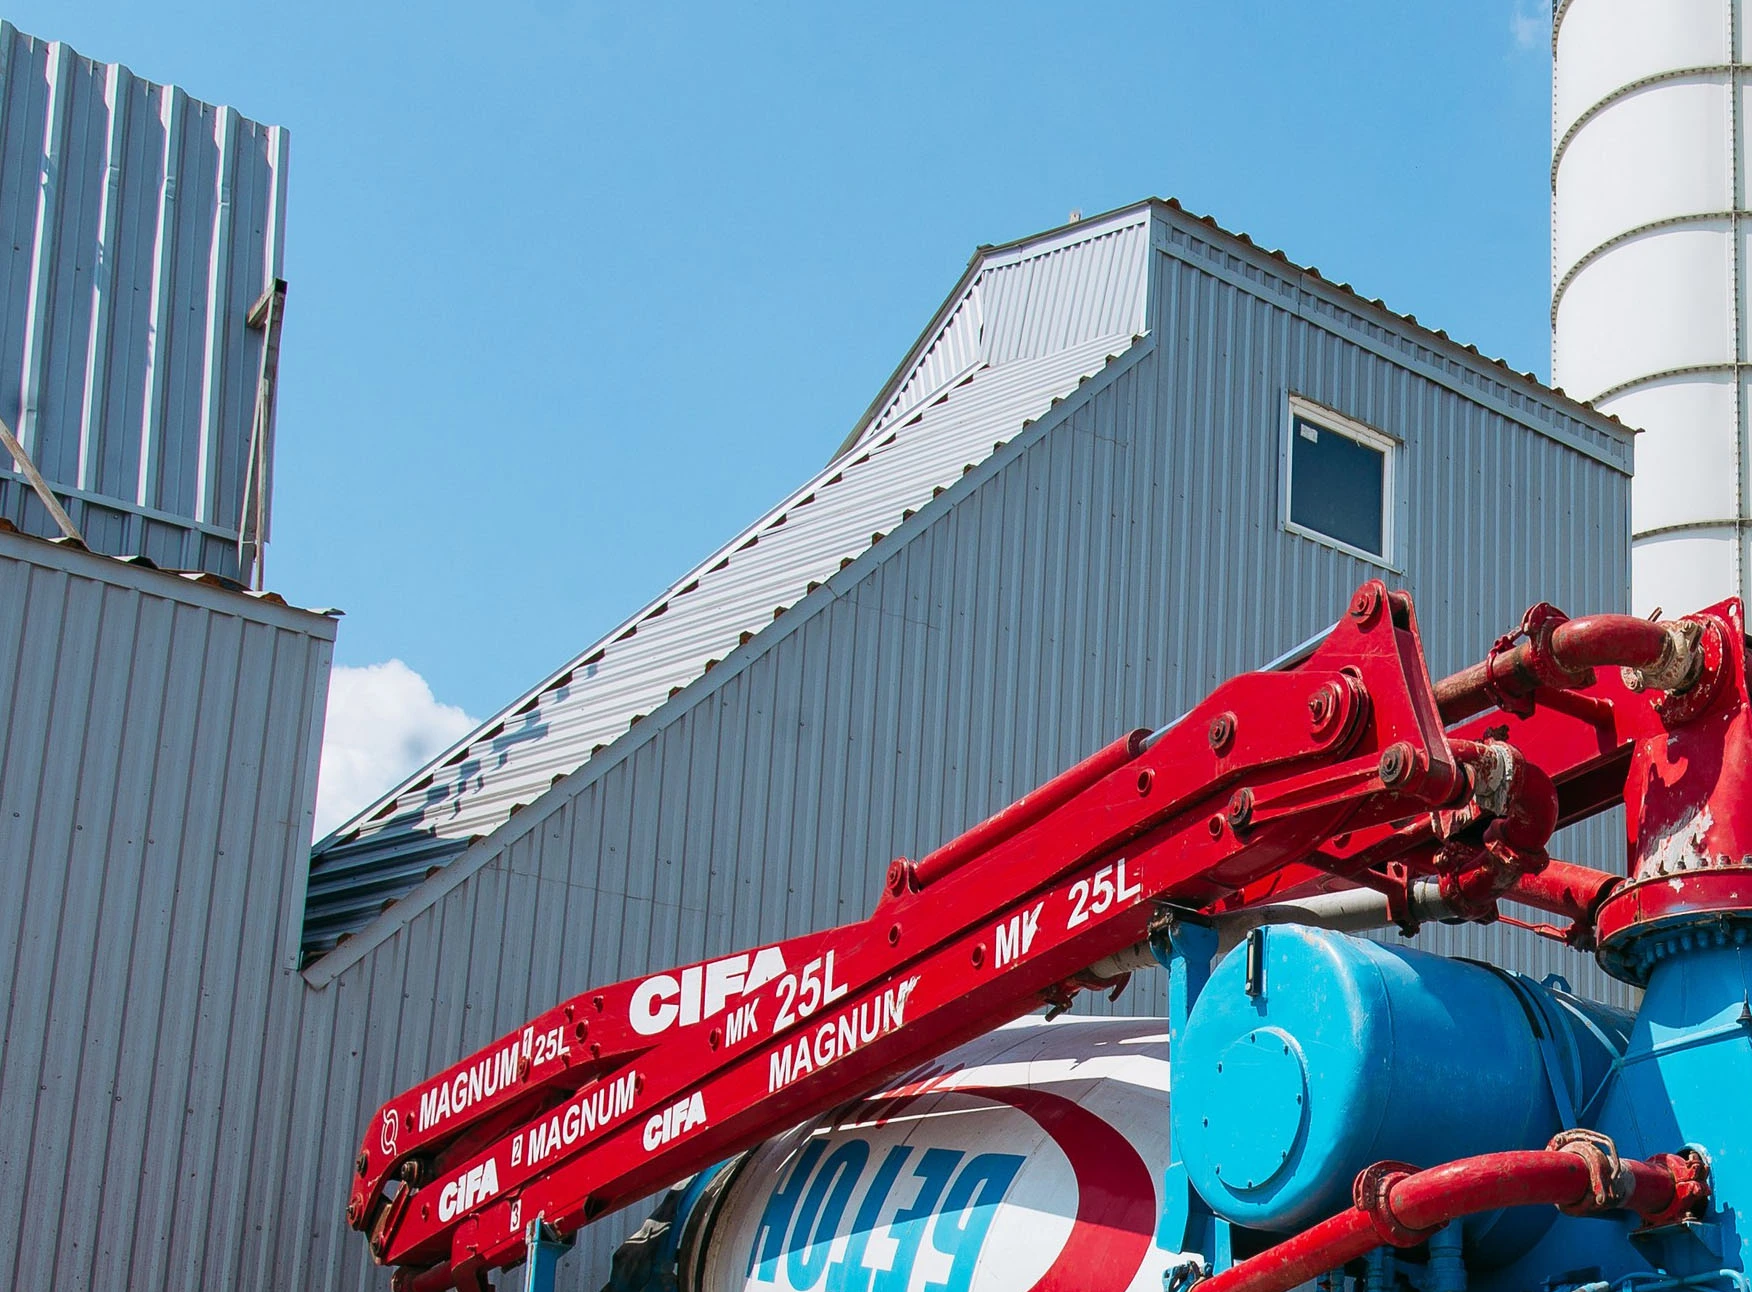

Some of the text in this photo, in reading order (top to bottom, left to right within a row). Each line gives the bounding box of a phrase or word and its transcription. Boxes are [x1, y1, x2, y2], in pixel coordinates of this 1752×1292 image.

[1066, 858, 1141, 930] 25L
[629, 946, 787, 1036] CIFA
[725, 950, 848, 1049] MK 25L
[418, 1025, 571, 1133] MAGNUM 25L
[527, 1070, 636, 1166] MAGNUM
[642, 1090, 708, 1152] CIFA
[438, 1157, 500, 1223] CIFA
